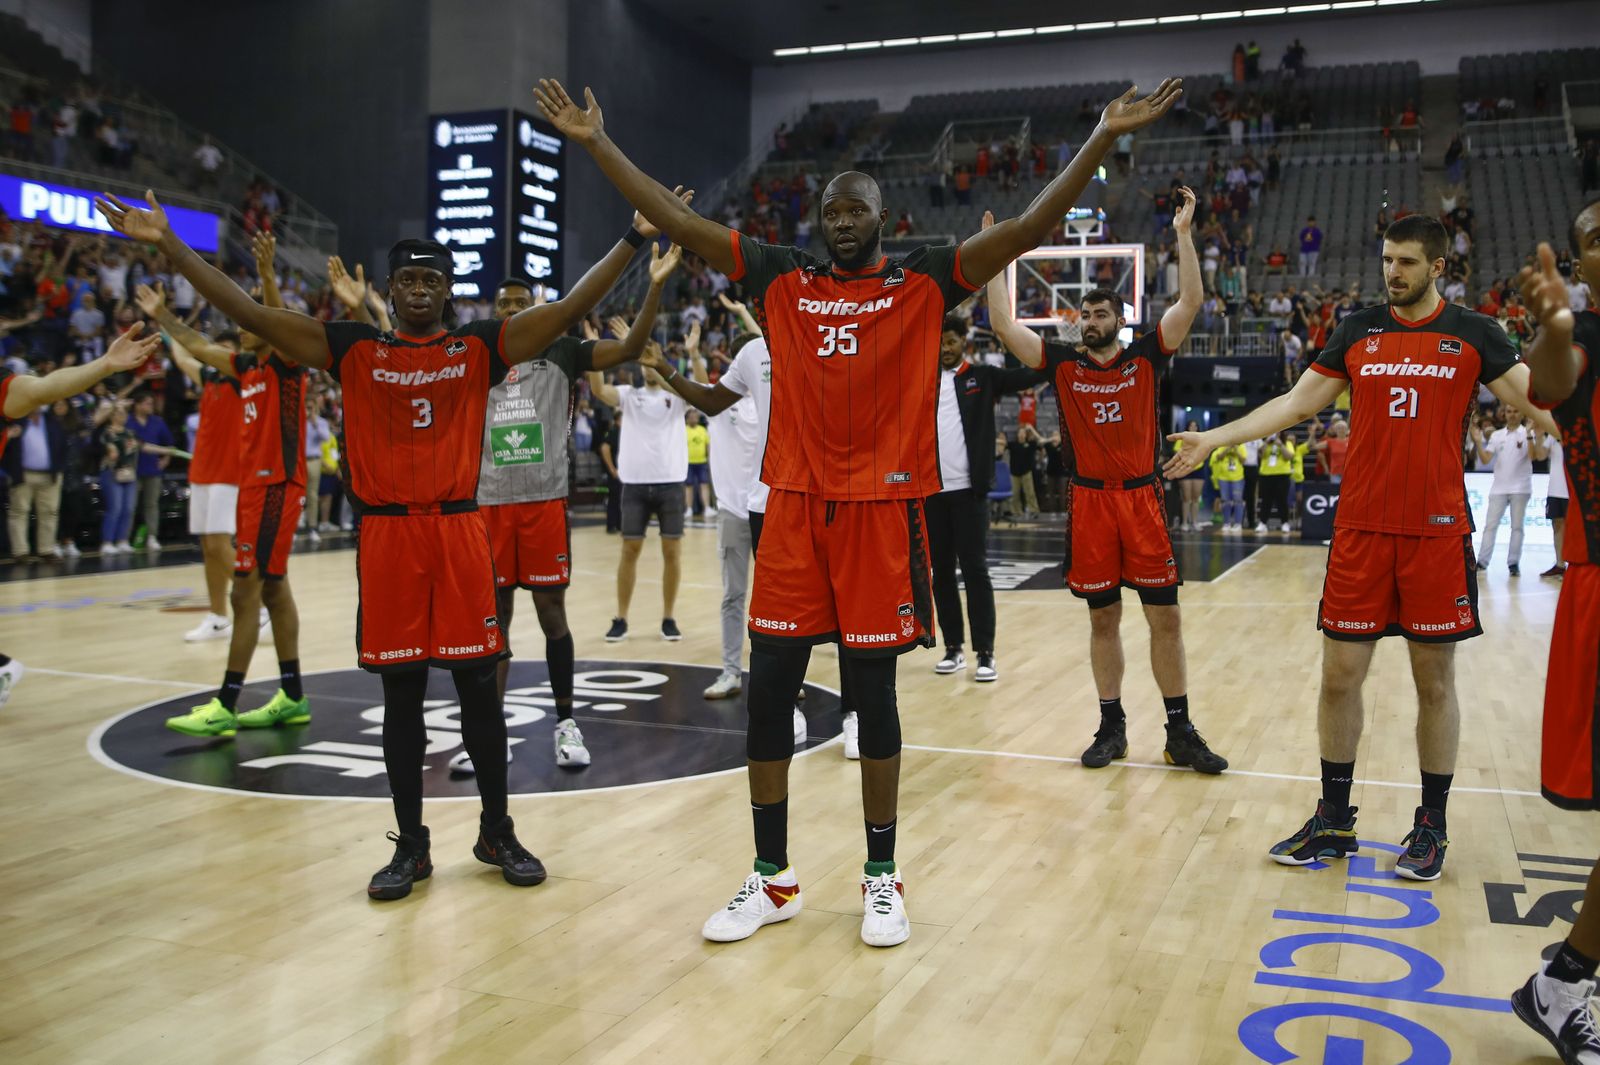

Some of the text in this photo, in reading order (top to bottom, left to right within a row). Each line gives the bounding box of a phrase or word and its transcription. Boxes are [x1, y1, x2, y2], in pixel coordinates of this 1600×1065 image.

[817, 322, 859, 357] 35
[411, 398, 433, 428] 3
[1092, 401, 1123, 424] 32
[1389, 386, 1419, 419] 21
[856, 633, 897, 643] BERNER
[1420, 622, 1456, 632] BERNER
[447, 645, 484, 655] BERNER
